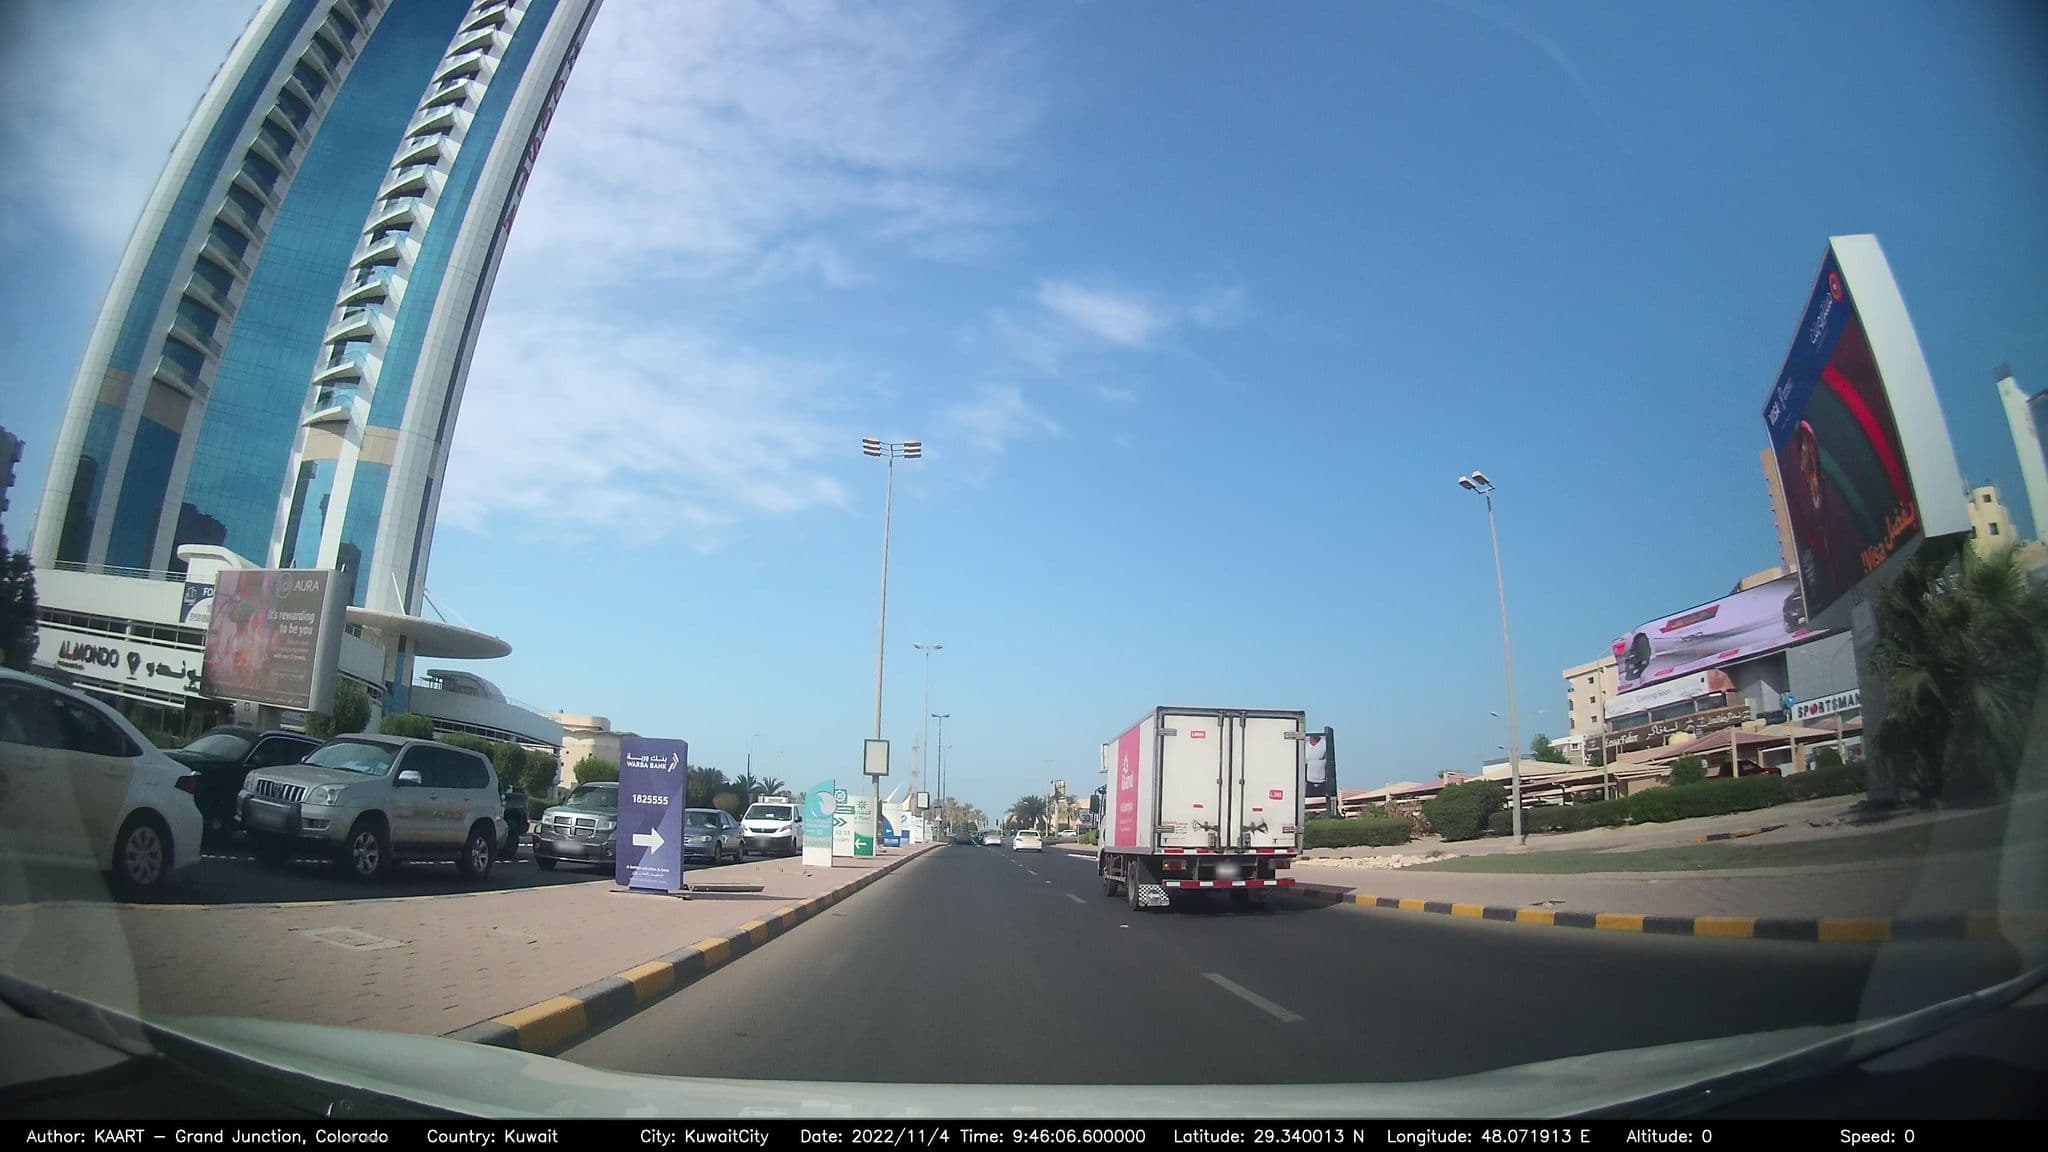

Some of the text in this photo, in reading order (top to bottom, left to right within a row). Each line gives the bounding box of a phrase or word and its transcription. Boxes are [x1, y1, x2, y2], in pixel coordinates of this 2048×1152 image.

[293, 579, 320, 592] AURA
[279, 609, 316, 624] rewarding
[280, 622, 313, 637] to be you
[58, 640, 120, 669] ALMONDO
[627, 760, 649, 769] WARBA
[632, 793, 669, 805] 1825555
